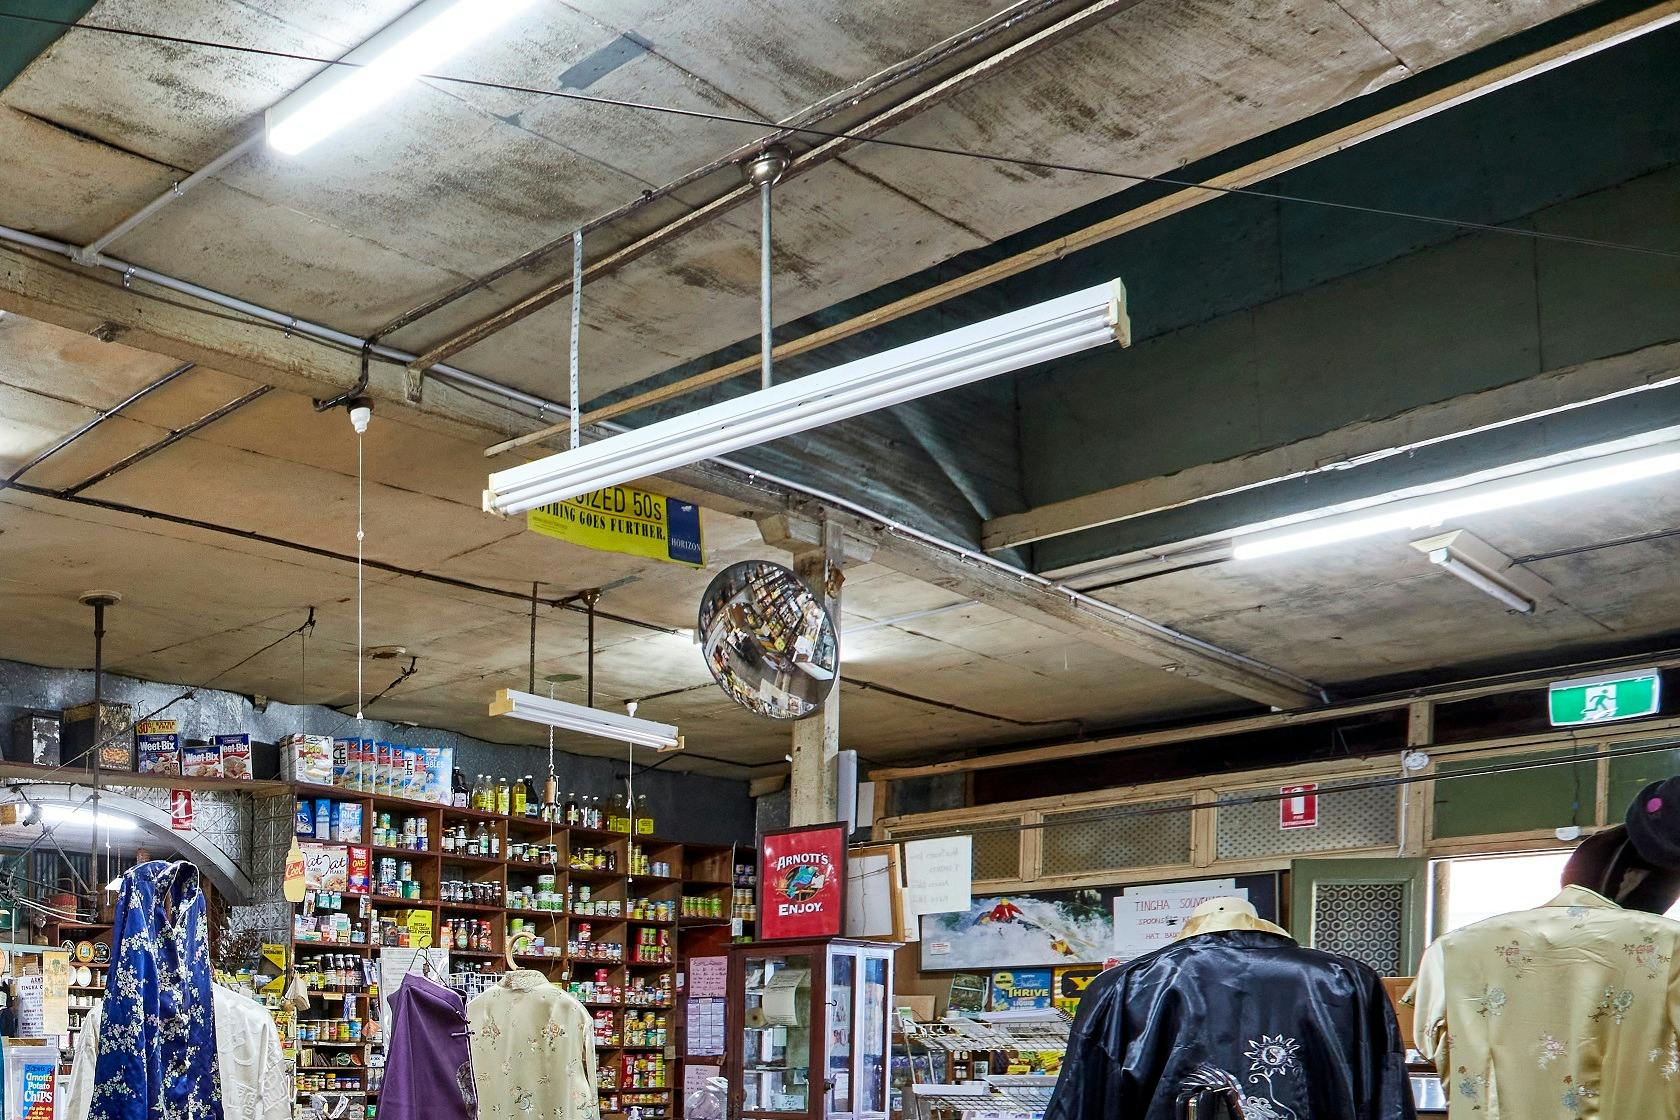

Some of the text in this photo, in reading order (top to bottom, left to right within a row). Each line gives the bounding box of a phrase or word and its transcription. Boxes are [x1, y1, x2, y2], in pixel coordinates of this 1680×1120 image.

[634, 492, 662, 520] 50s
[580, 511, 605, 530] GOES
[611, 518, 666, 540] FURTHER.
[671, 538, 701, 552] HORIZON
[137, 722, 156, 735] 30%
[139, 741, 175, 752] Weet-Bix
[185, 752, 219, 762] Weet-Bix
[341, 810, 359, 820] RICE
[776, 852, 829, 871] ARNOTT'S
[286, 862, 304, 877] Cool
[778, 902, 824, 916] ENJOY.
[1007, 988, 1049, 998] THRIVE
[28, 1081, 50, 1089] Potato
